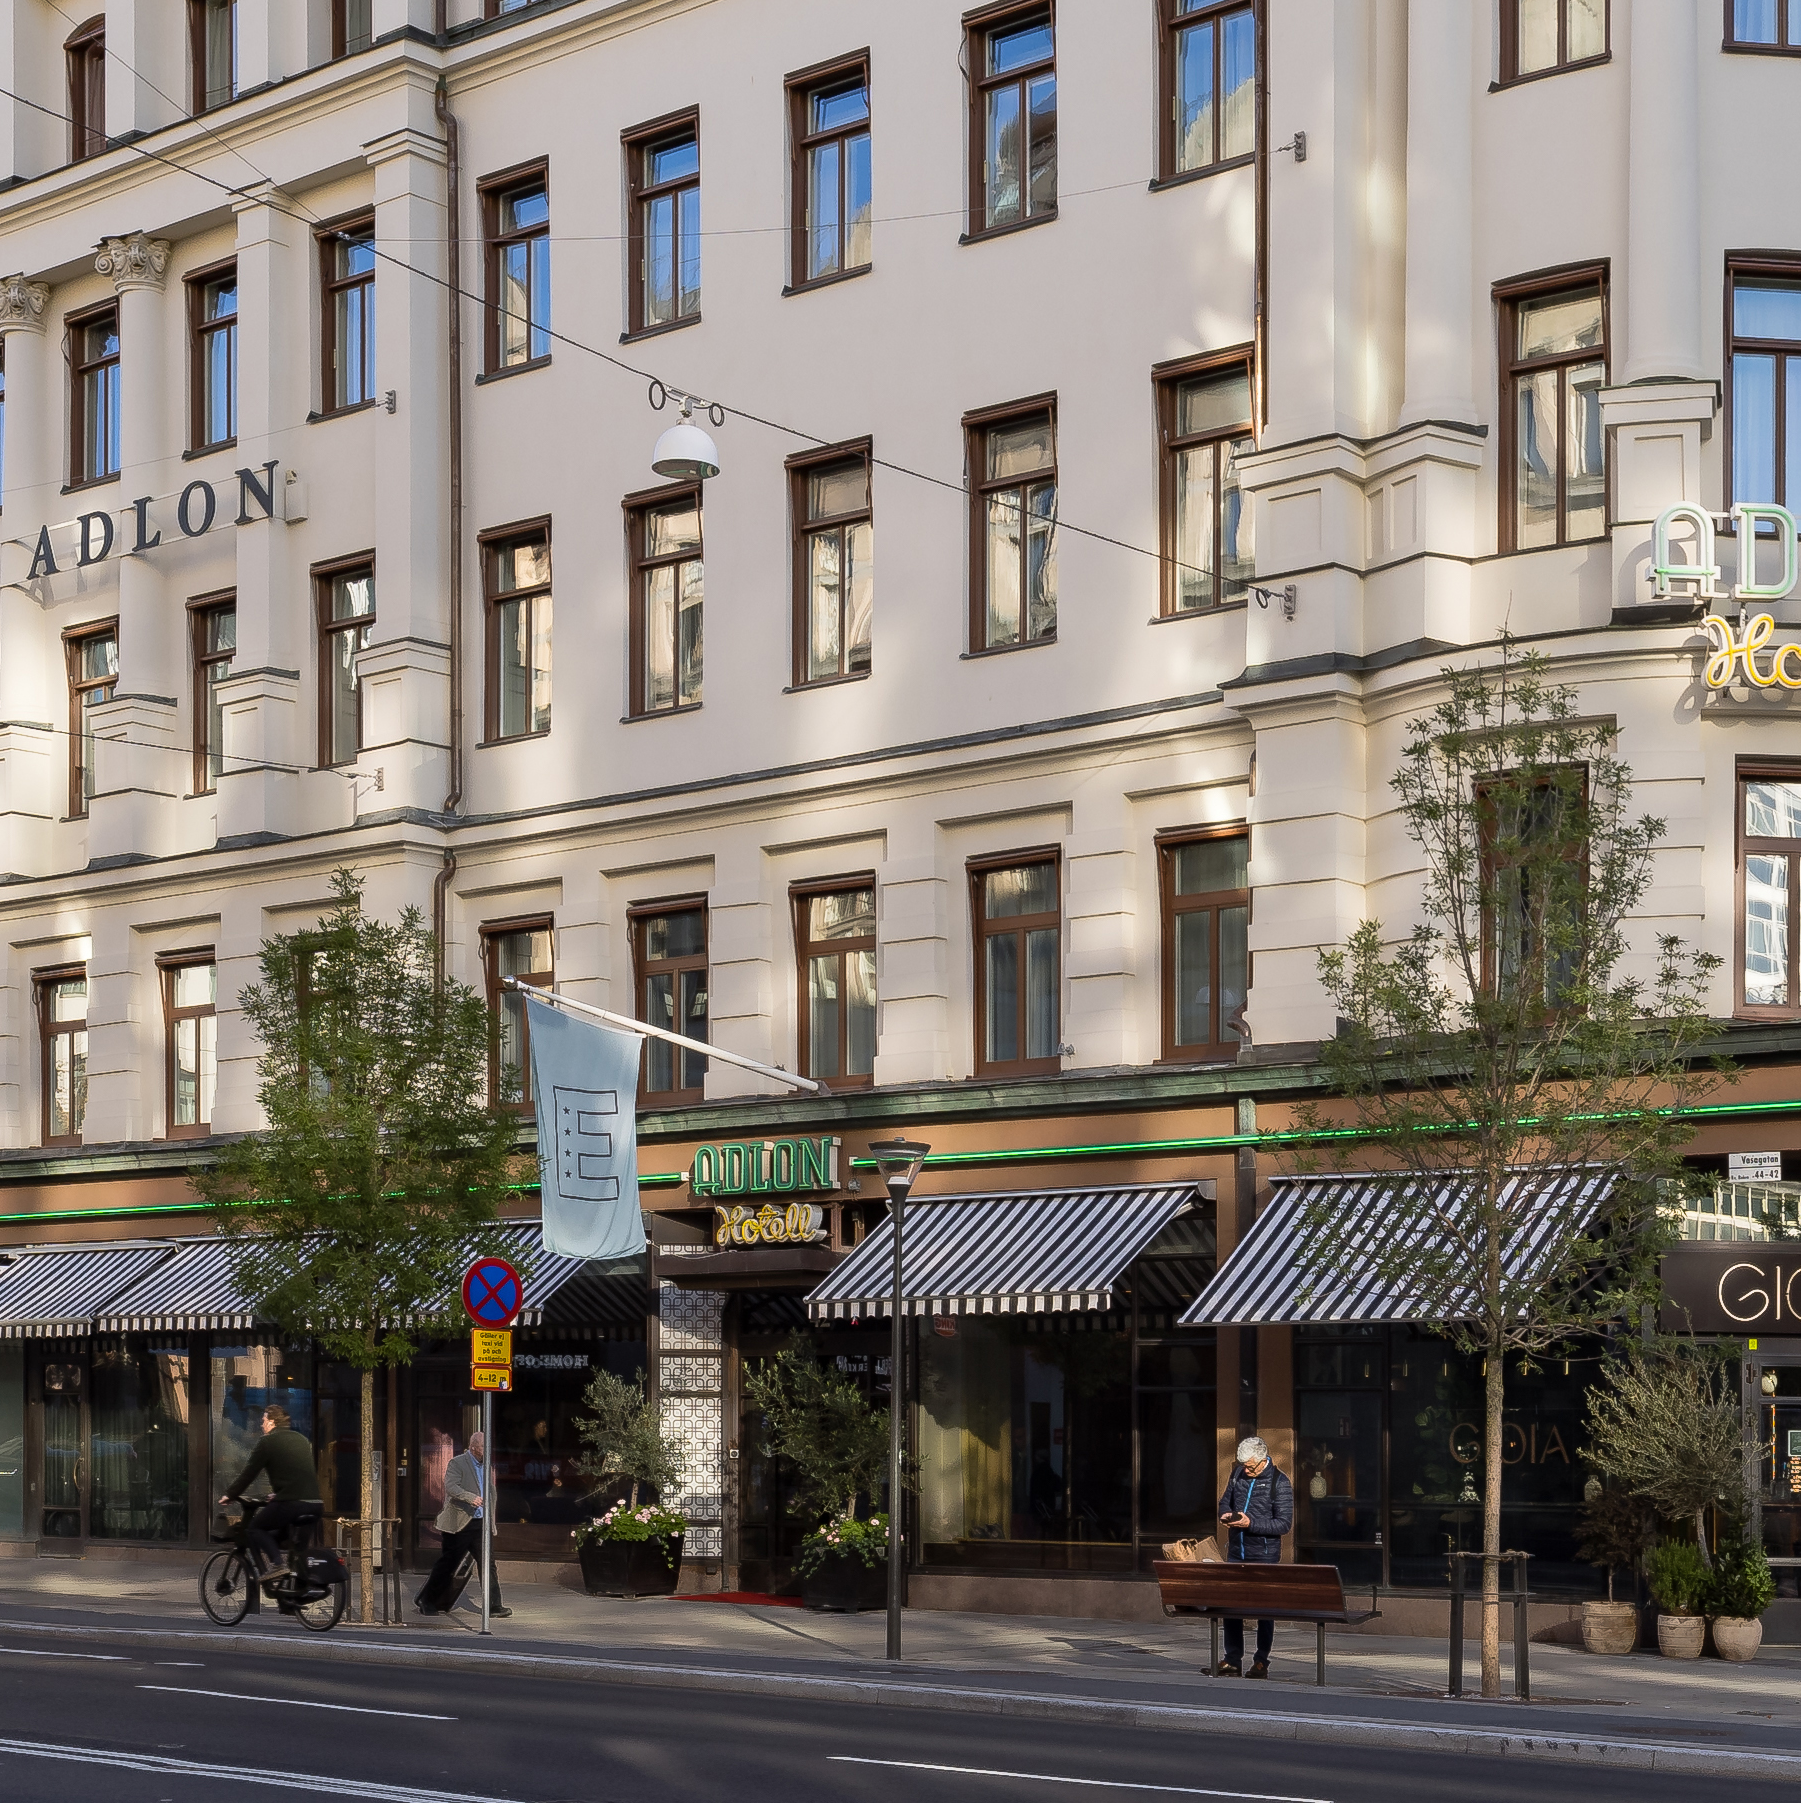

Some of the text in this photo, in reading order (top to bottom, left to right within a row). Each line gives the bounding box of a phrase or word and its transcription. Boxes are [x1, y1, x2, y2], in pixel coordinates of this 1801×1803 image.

[27, 460, 280, 581] ADLON
[693, 1136, 839, 1197] ADLON
[1741, 1156, 1779, 1166] Vasagatan
[715, 1202, 827, 1246] Hotell
[478, 1374, 497, 1382] 4-12
[1448, 1423, 1571, 1464] GOIA
